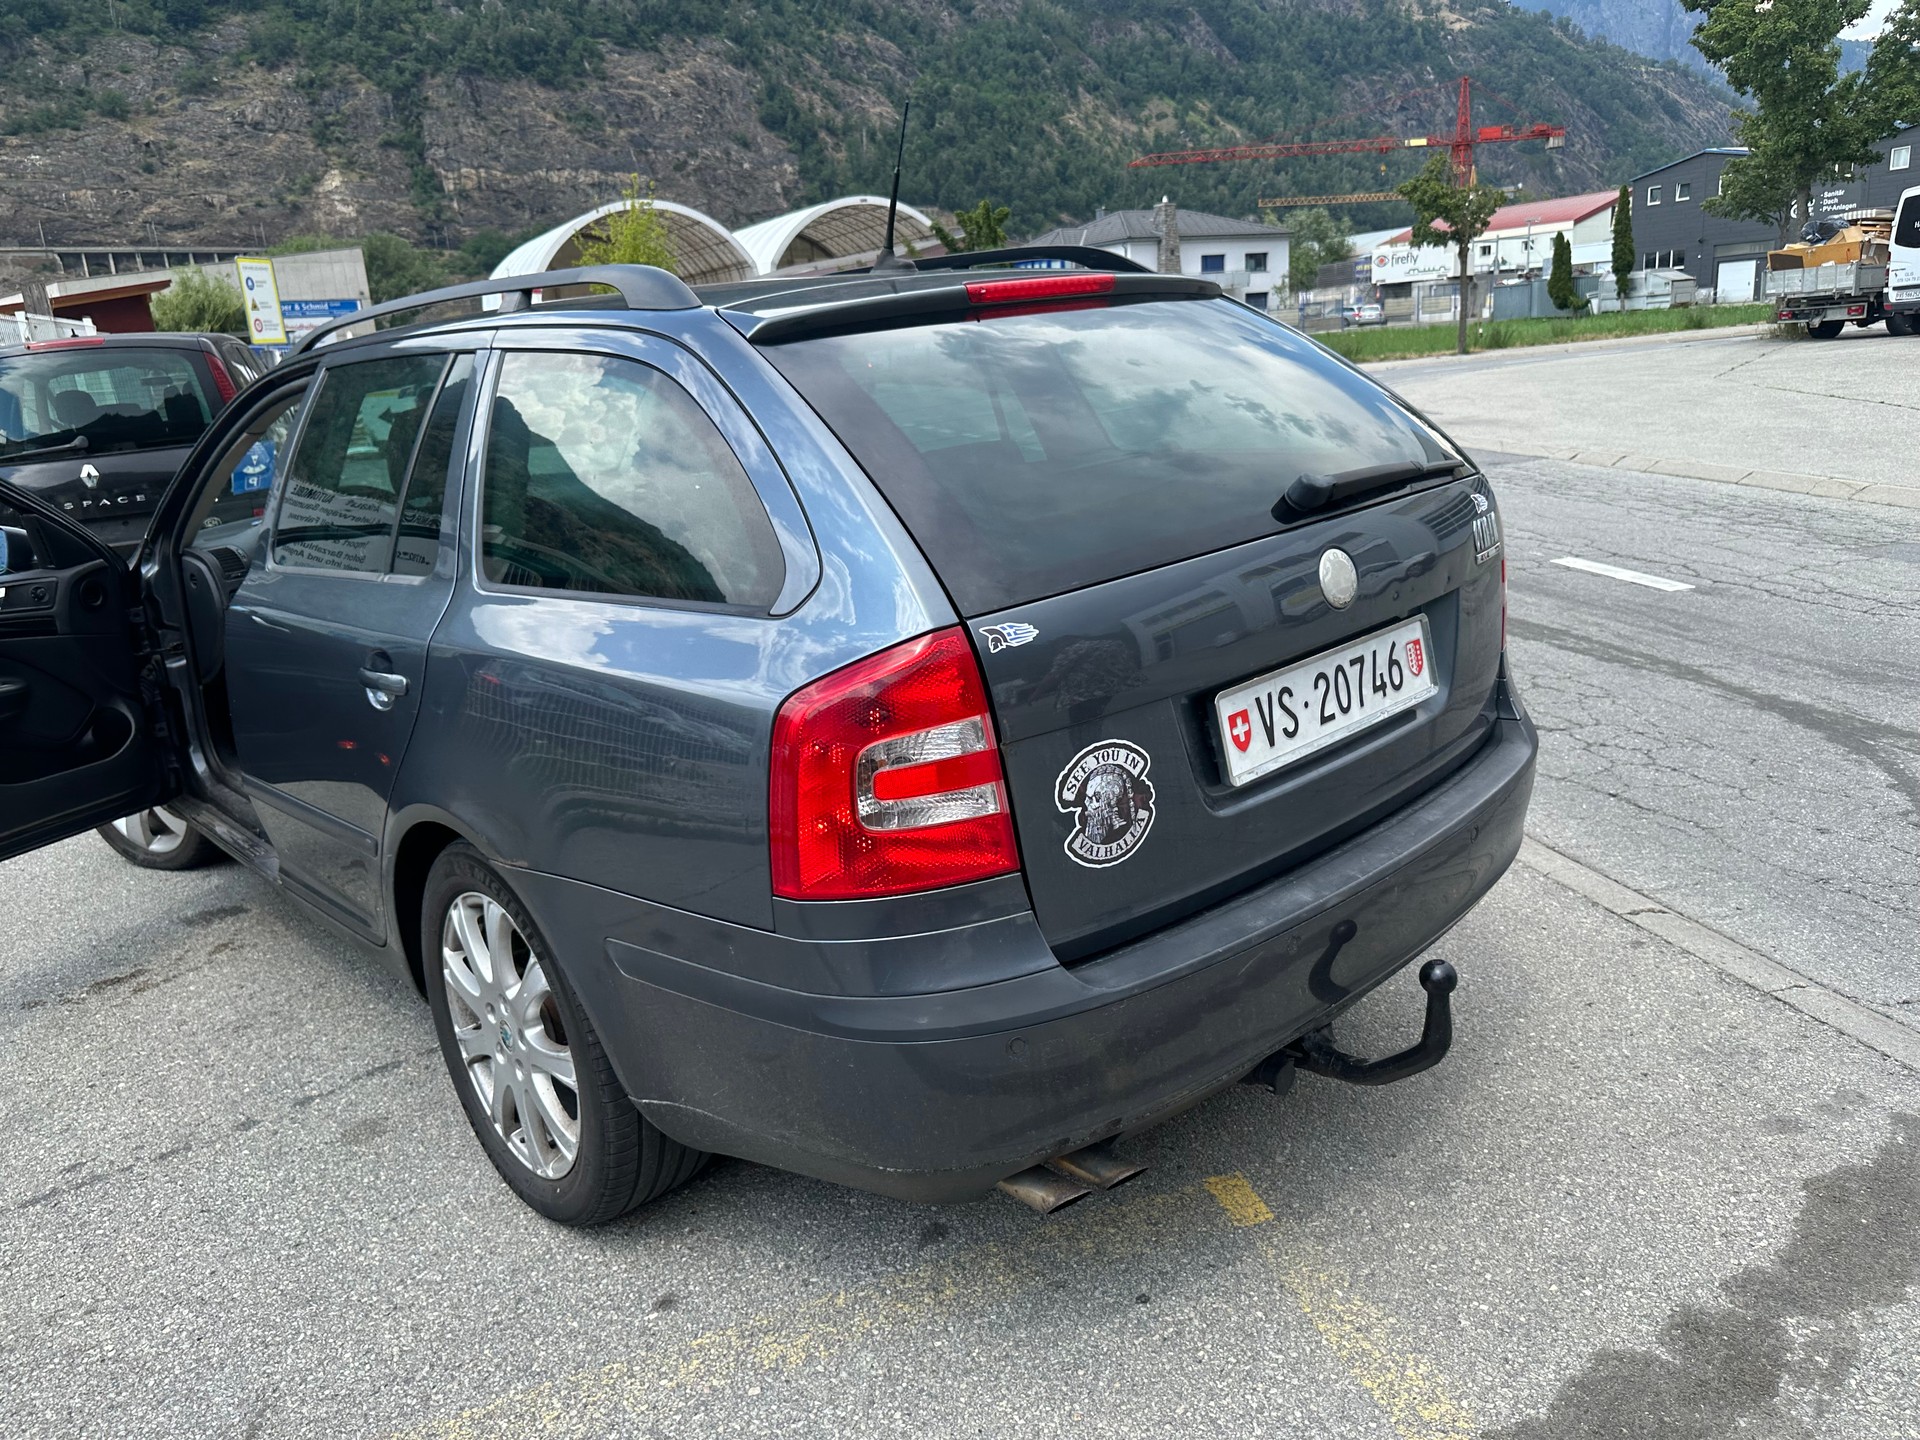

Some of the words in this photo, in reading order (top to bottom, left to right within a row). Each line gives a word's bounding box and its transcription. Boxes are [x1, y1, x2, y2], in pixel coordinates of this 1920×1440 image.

[1824, 189, 1845, 198] Sanitär
[1823, 198, 1839, 206] Dach
[1823, 203, 1857, 213] PV-Anlagen
[1391, 252, 1419, 267] firefly
[302, 302, 328, 310] Schmid
[51, 494, 147, 510] SPACE
[1066, 761, 1091, 794] SEE
[1093, 749, 1120, 766] YOU
[1124, 753, 1140, 770] IN
[1078, 817, 1146, 858] VALHALLA
